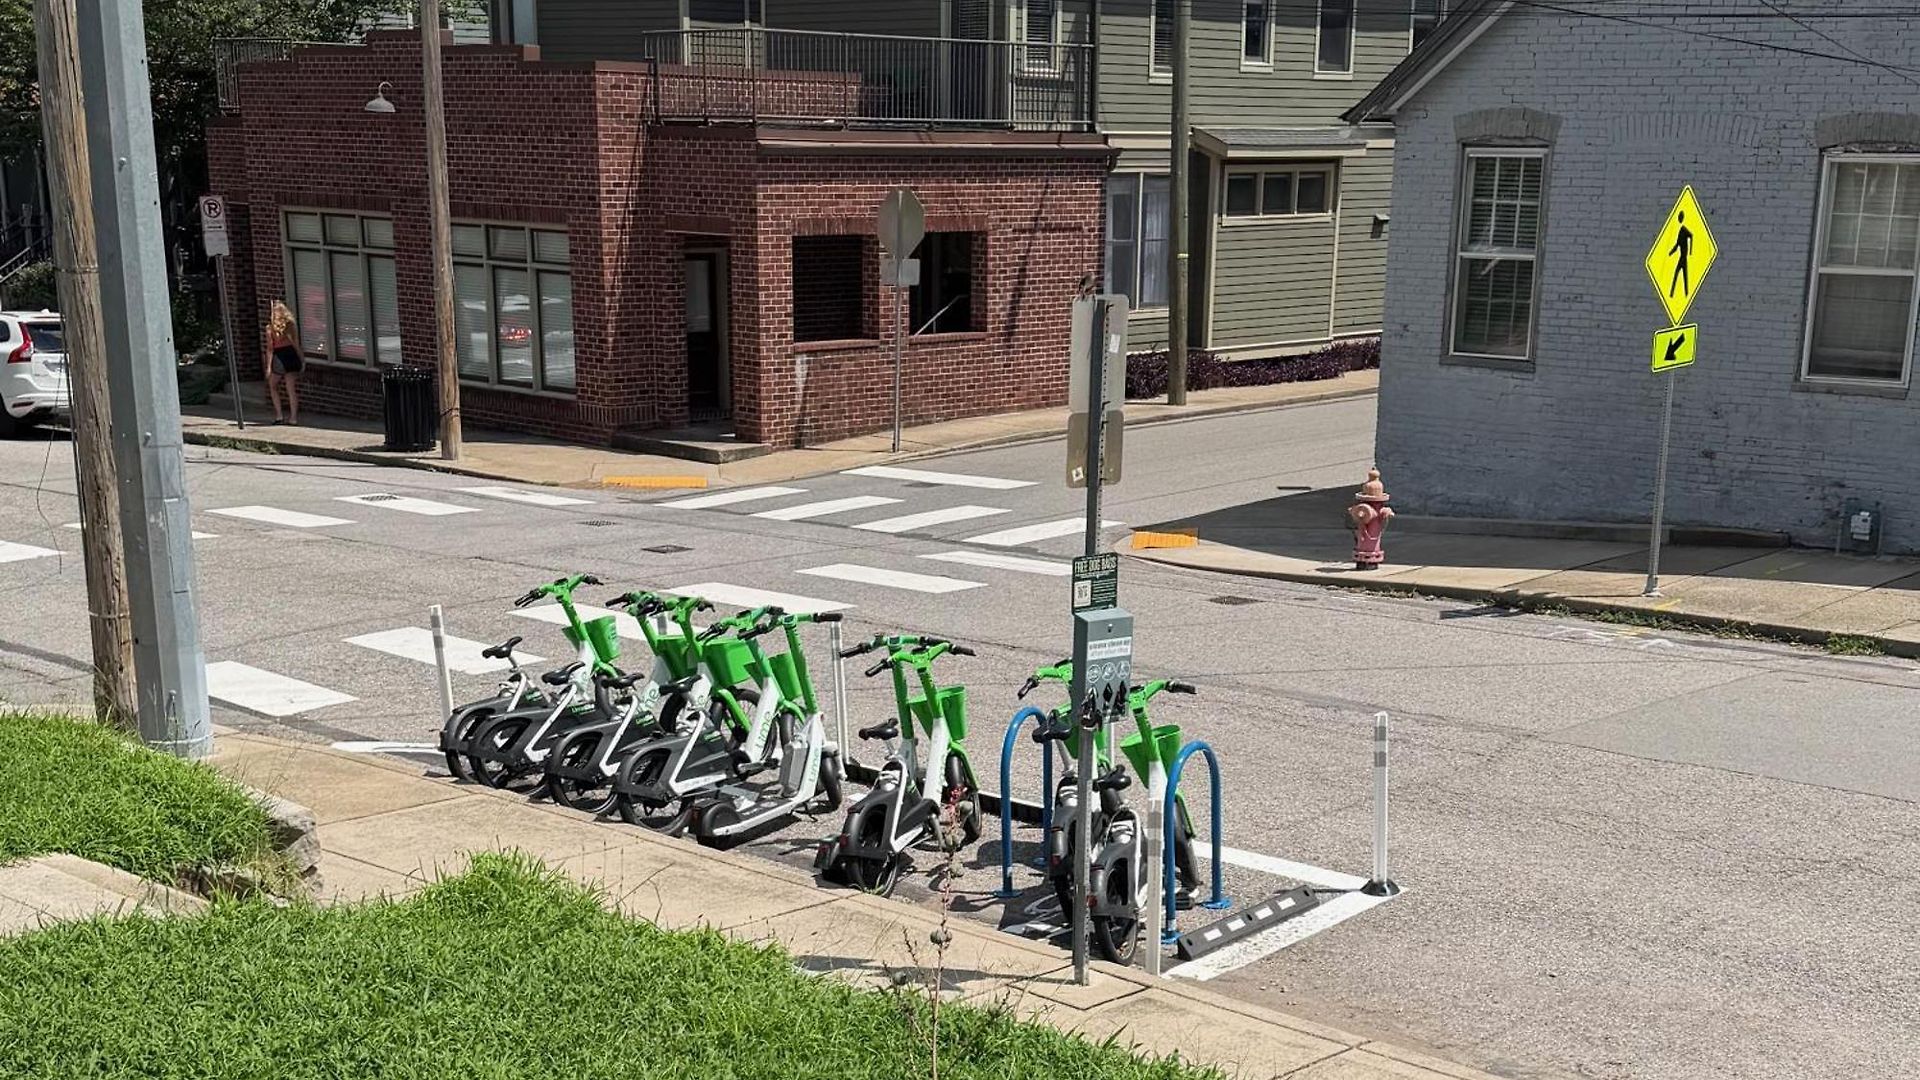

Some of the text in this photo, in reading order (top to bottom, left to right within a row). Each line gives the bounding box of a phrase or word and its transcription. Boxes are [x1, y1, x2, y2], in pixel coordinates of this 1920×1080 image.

[1074, 561, 1089, 574] FREE
[1089, 558, 1101, 571] DOG
[1102, 556, 1117, 569] BAGS
